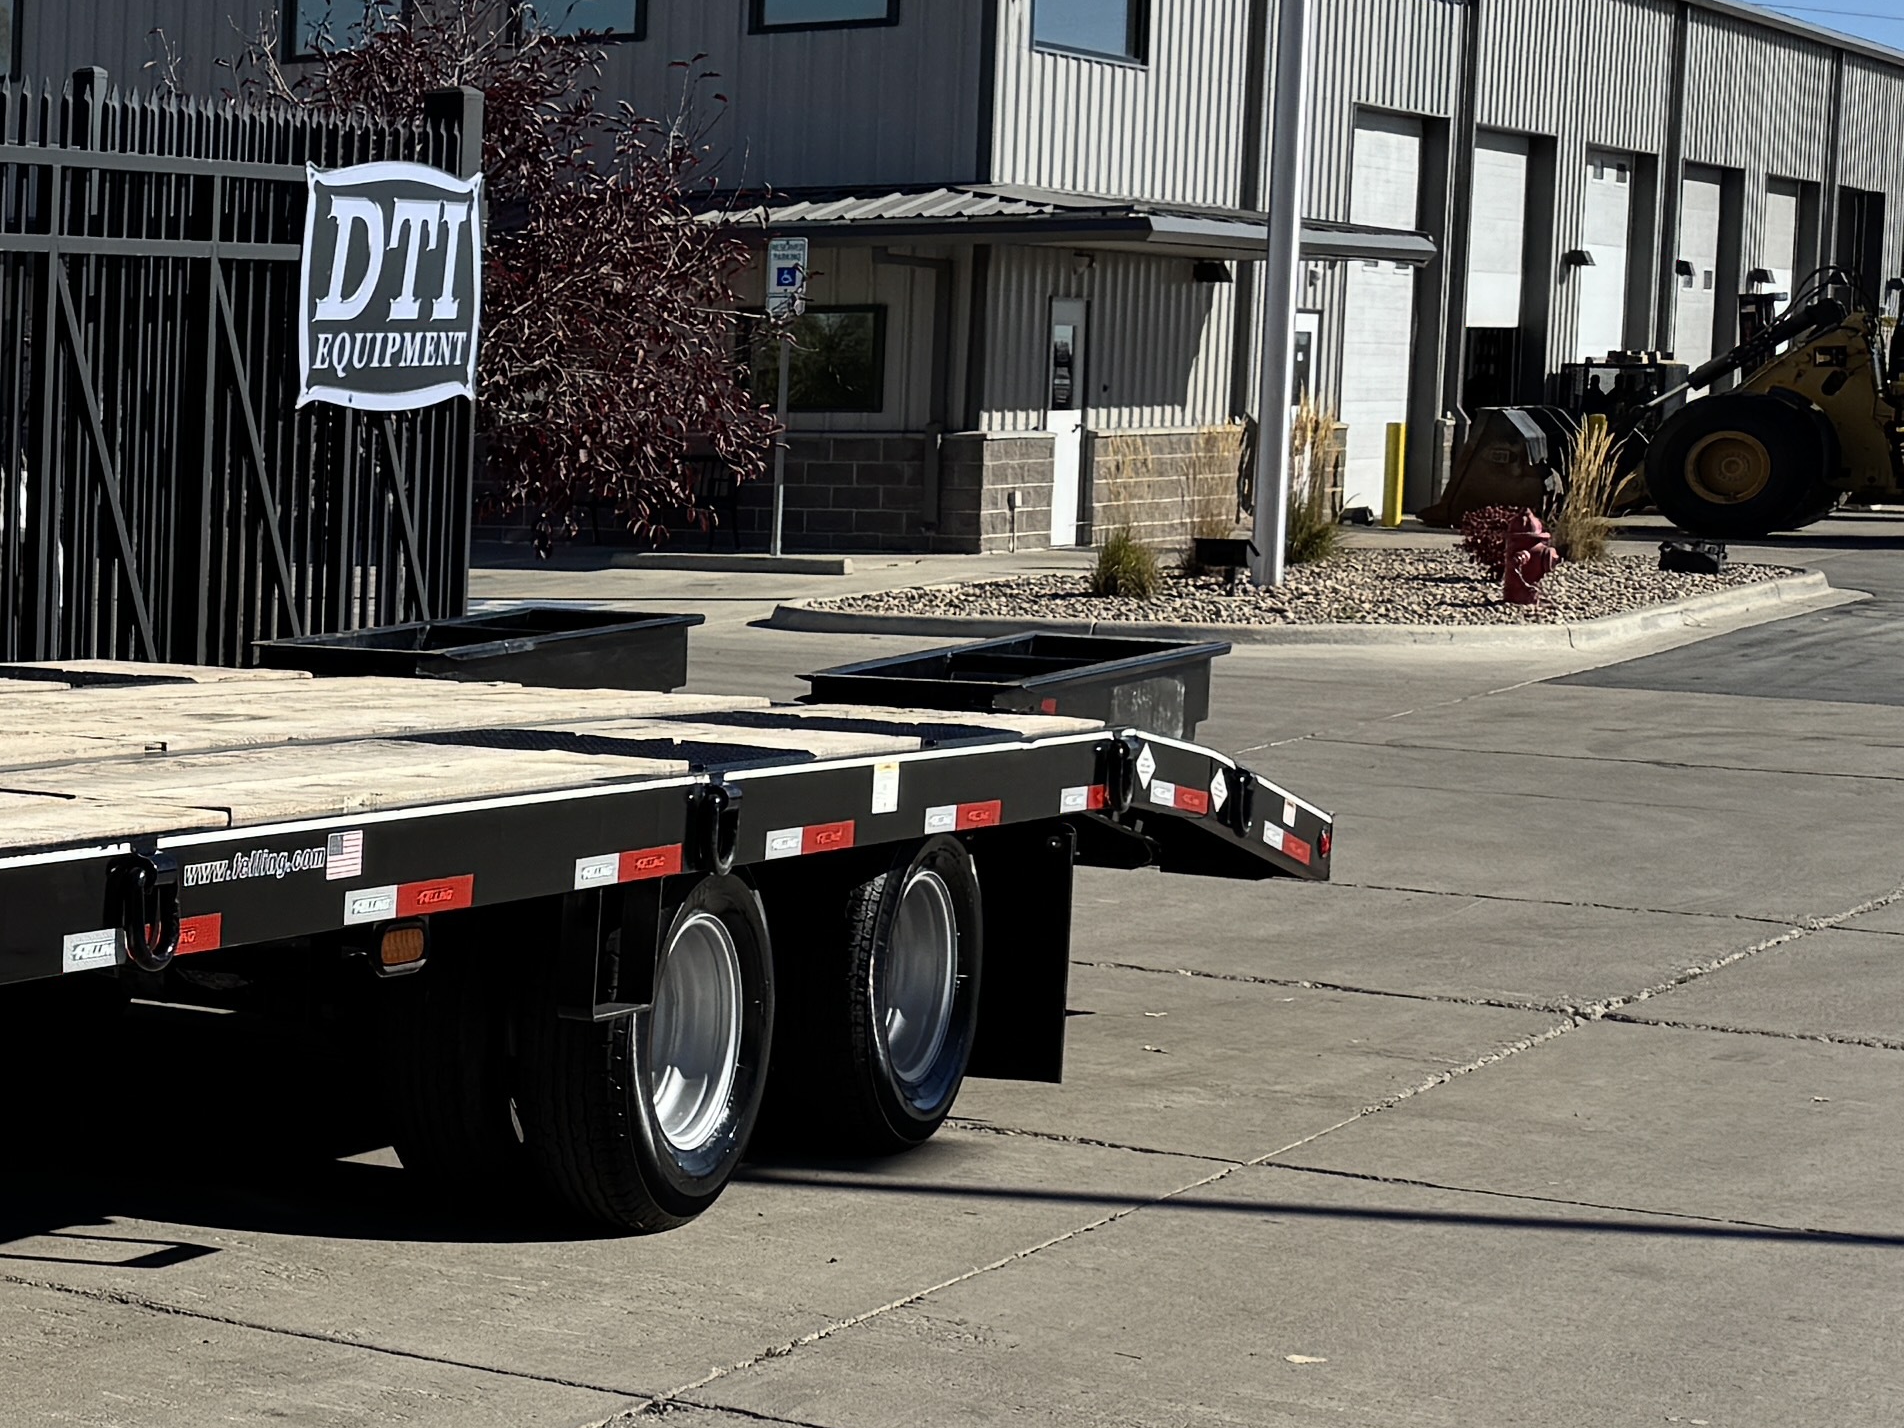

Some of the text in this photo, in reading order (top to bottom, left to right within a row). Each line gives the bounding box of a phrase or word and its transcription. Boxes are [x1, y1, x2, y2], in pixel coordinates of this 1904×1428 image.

[311, 195, 470, 322] DTI
[312, 332, 467, 378] EQUIPMENT
[183, 844, 326, 888] www.felling.com
